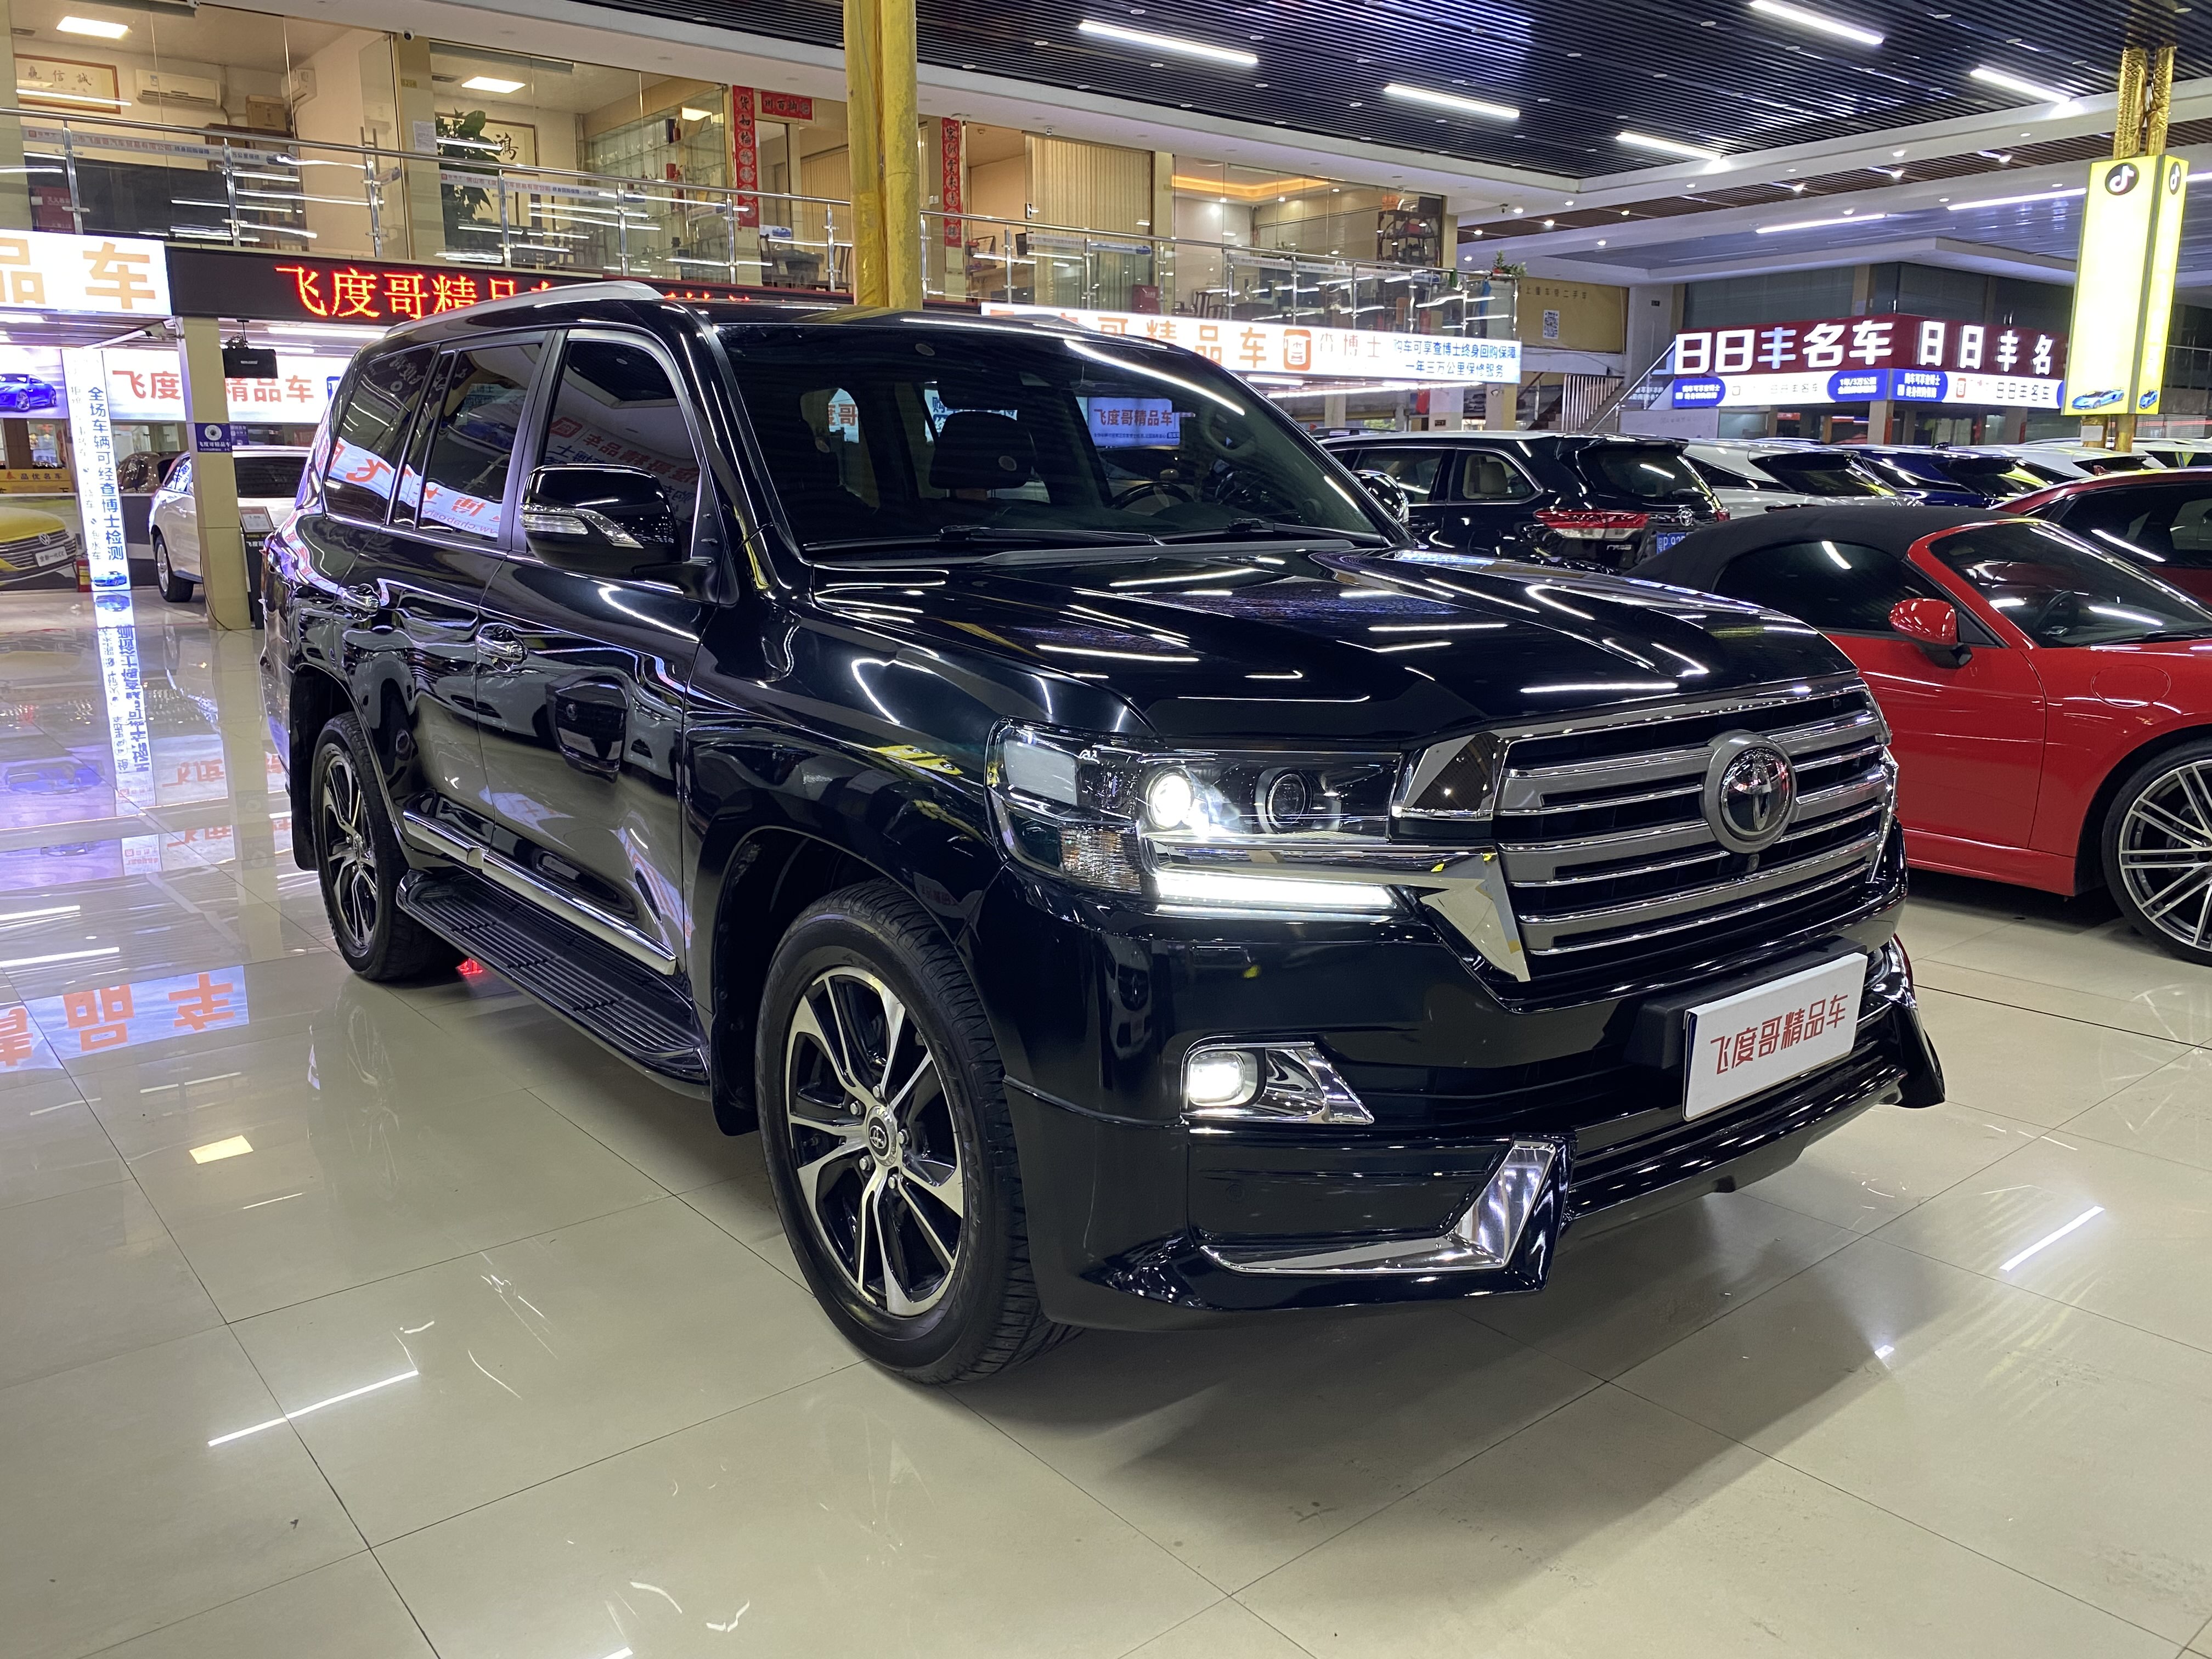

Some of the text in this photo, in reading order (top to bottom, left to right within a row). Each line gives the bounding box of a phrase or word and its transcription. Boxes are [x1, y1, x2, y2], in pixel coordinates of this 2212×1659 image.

[1674, 320, 1894, 375] 日日丰名车
[1405, 360, 1504, 377] 一年三万公里保修服务
[1093, 409, 1173, 426] 飞度哥精品车
[1710, 994, 1848, 1075] 飞度哥精品车
